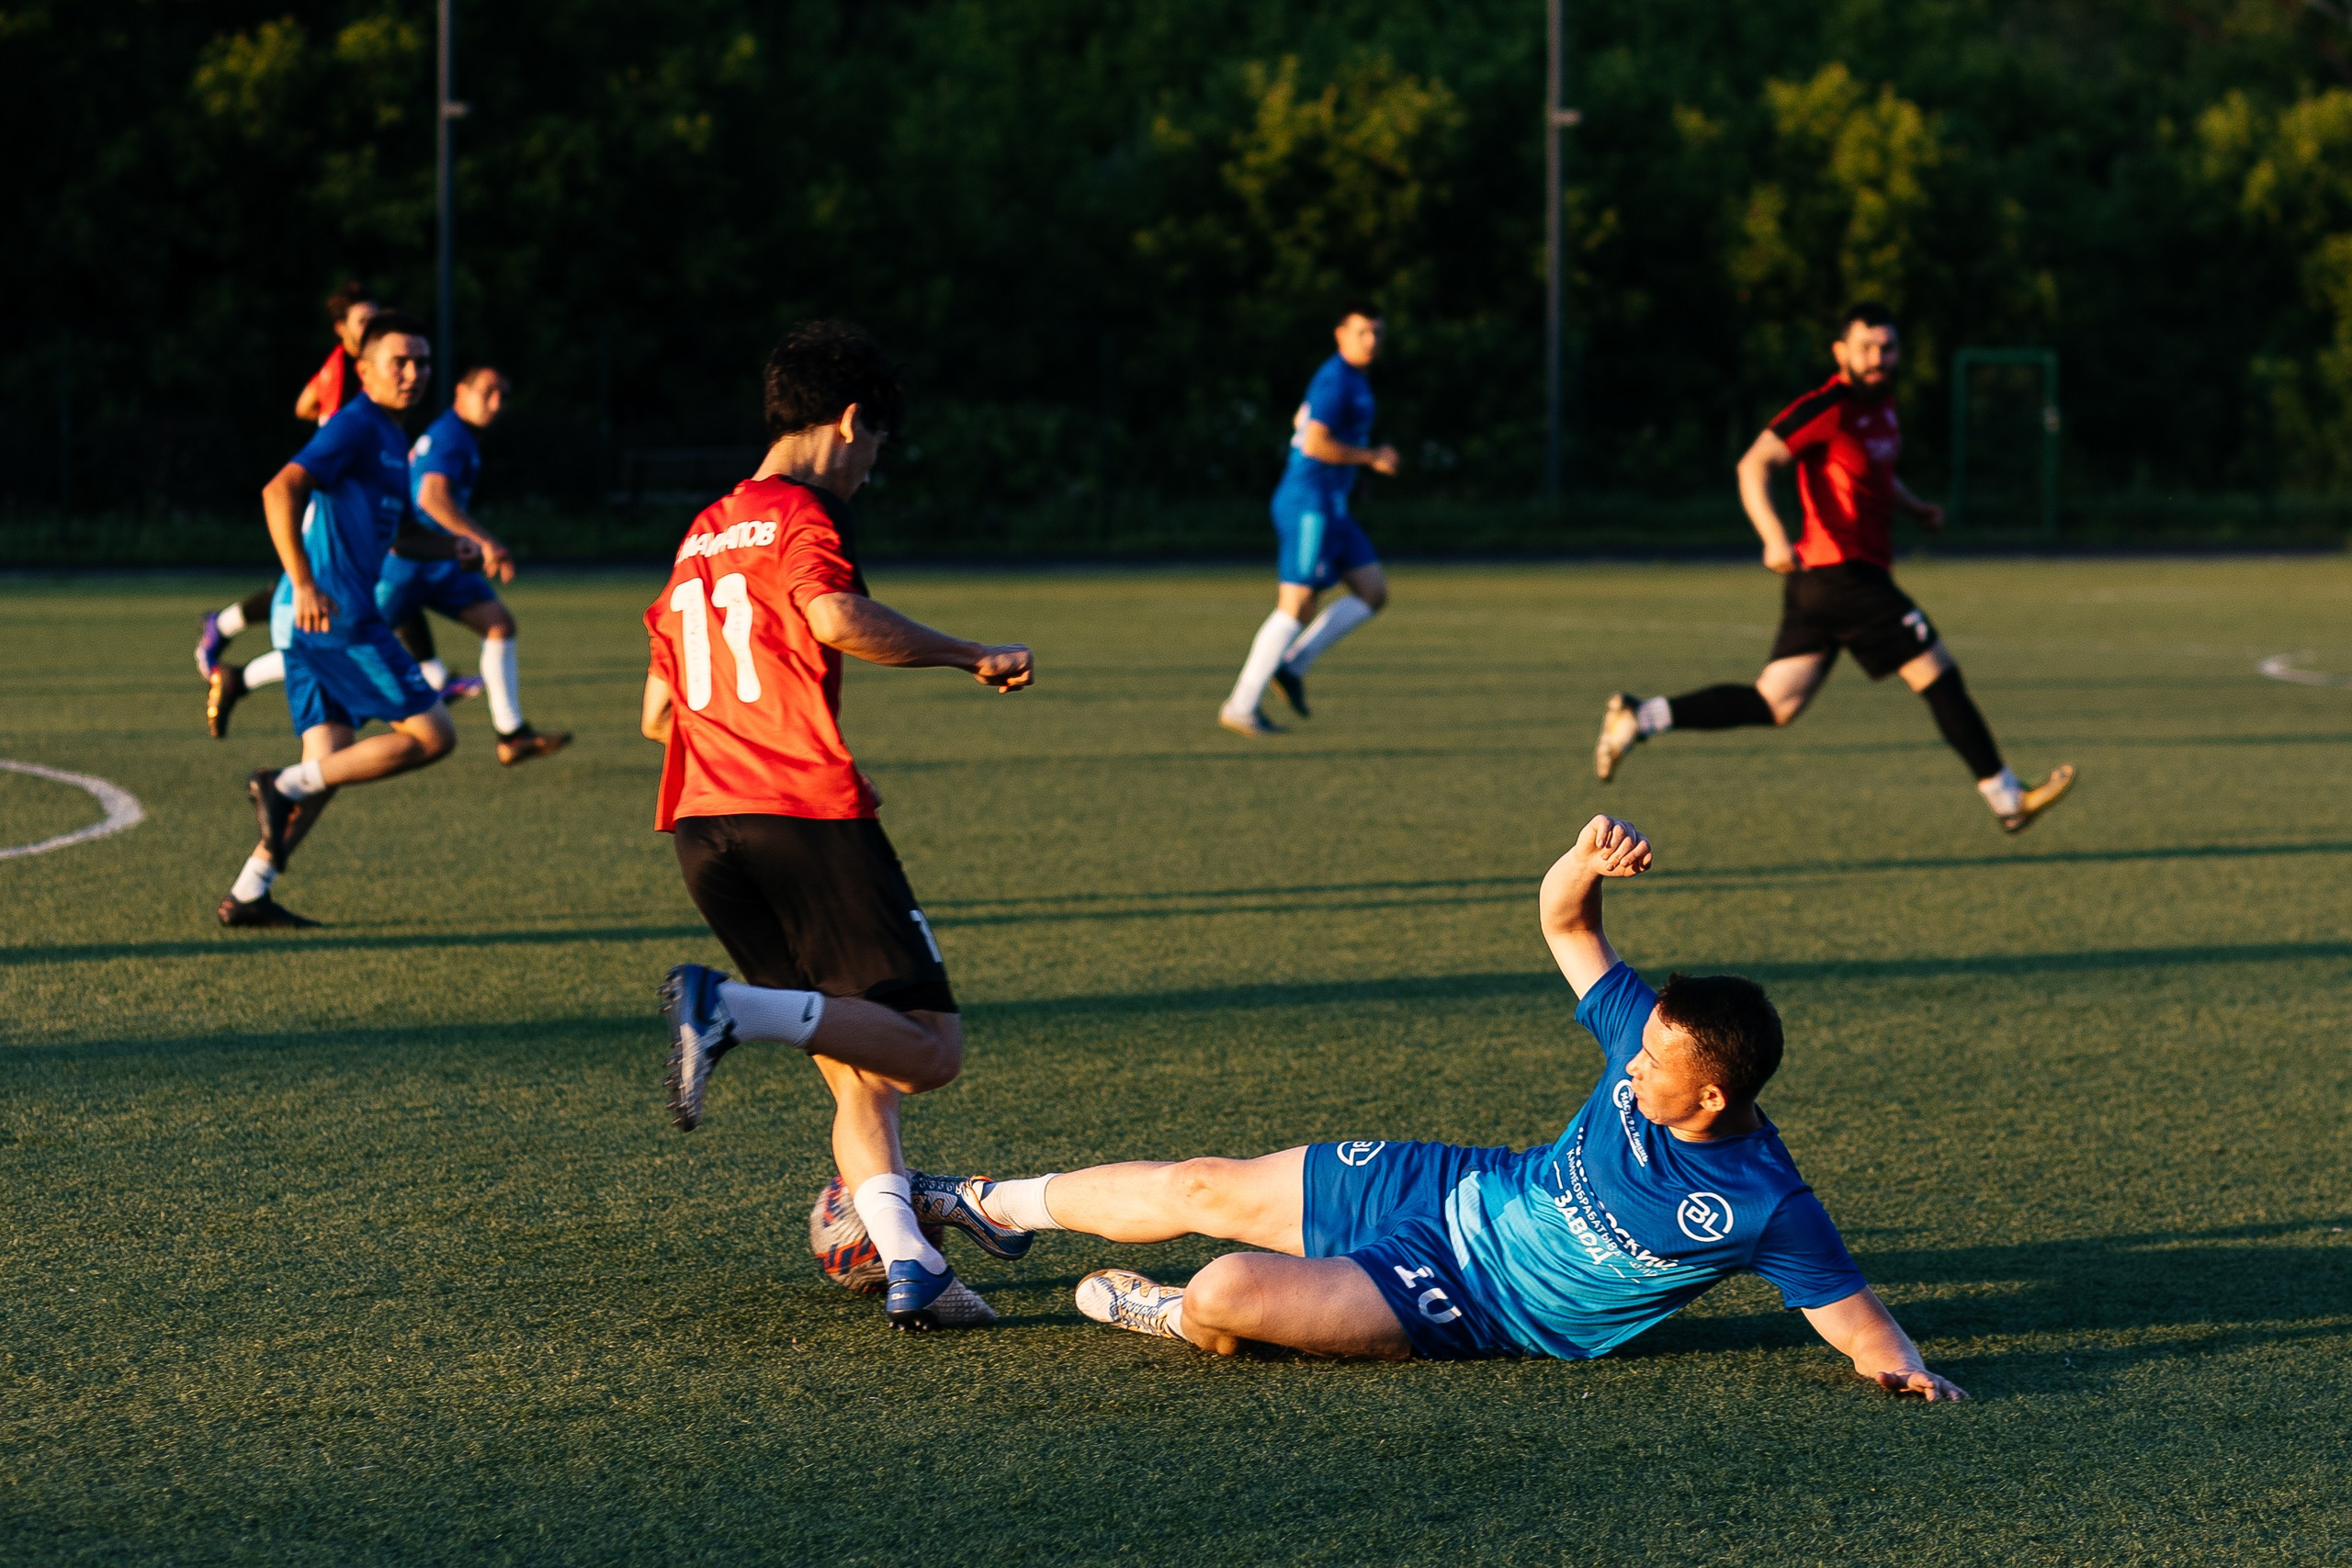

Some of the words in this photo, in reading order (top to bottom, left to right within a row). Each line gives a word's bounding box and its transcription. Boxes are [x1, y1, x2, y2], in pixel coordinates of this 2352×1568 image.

[671, 572, 762, 711] 11
[1554, 1190, 1612, 1266] ЗАВОД
[1683, 1200, 1726, 1239] BL
